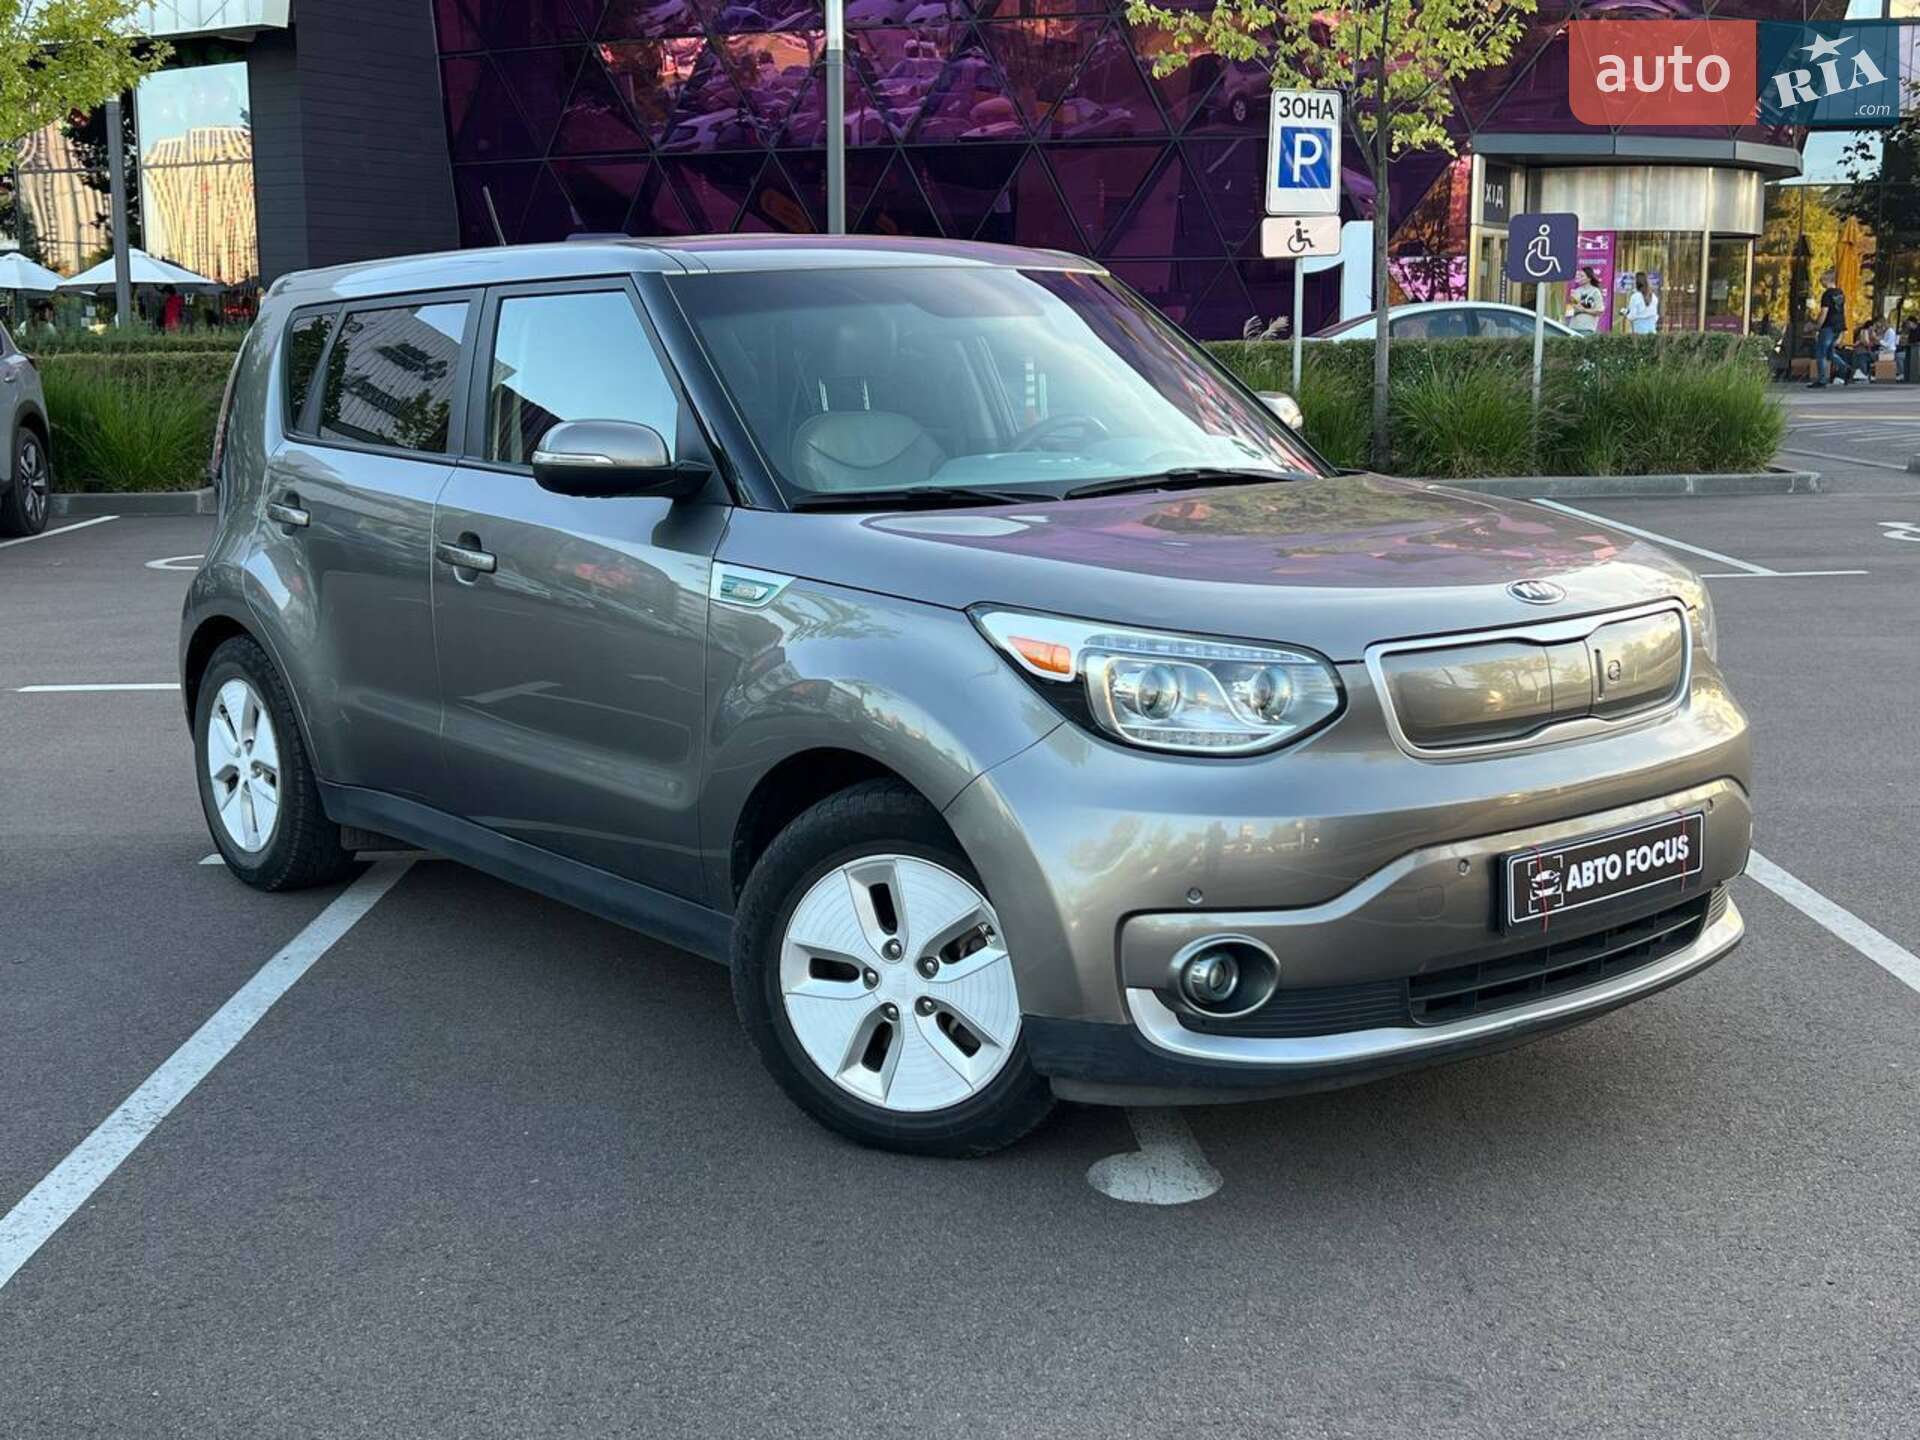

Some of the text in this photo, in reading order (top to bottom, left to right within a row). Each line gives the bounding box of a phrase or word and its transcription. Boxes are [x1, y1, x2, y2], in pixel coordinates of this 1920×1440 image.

[1279, 97, 1335, 120] ЗОНА
[1292, 132, 1323, 183] P
[1485, 183, 1504, 209] ХІД
[1566, 834, 1689, 892] АВТО FOCUS
